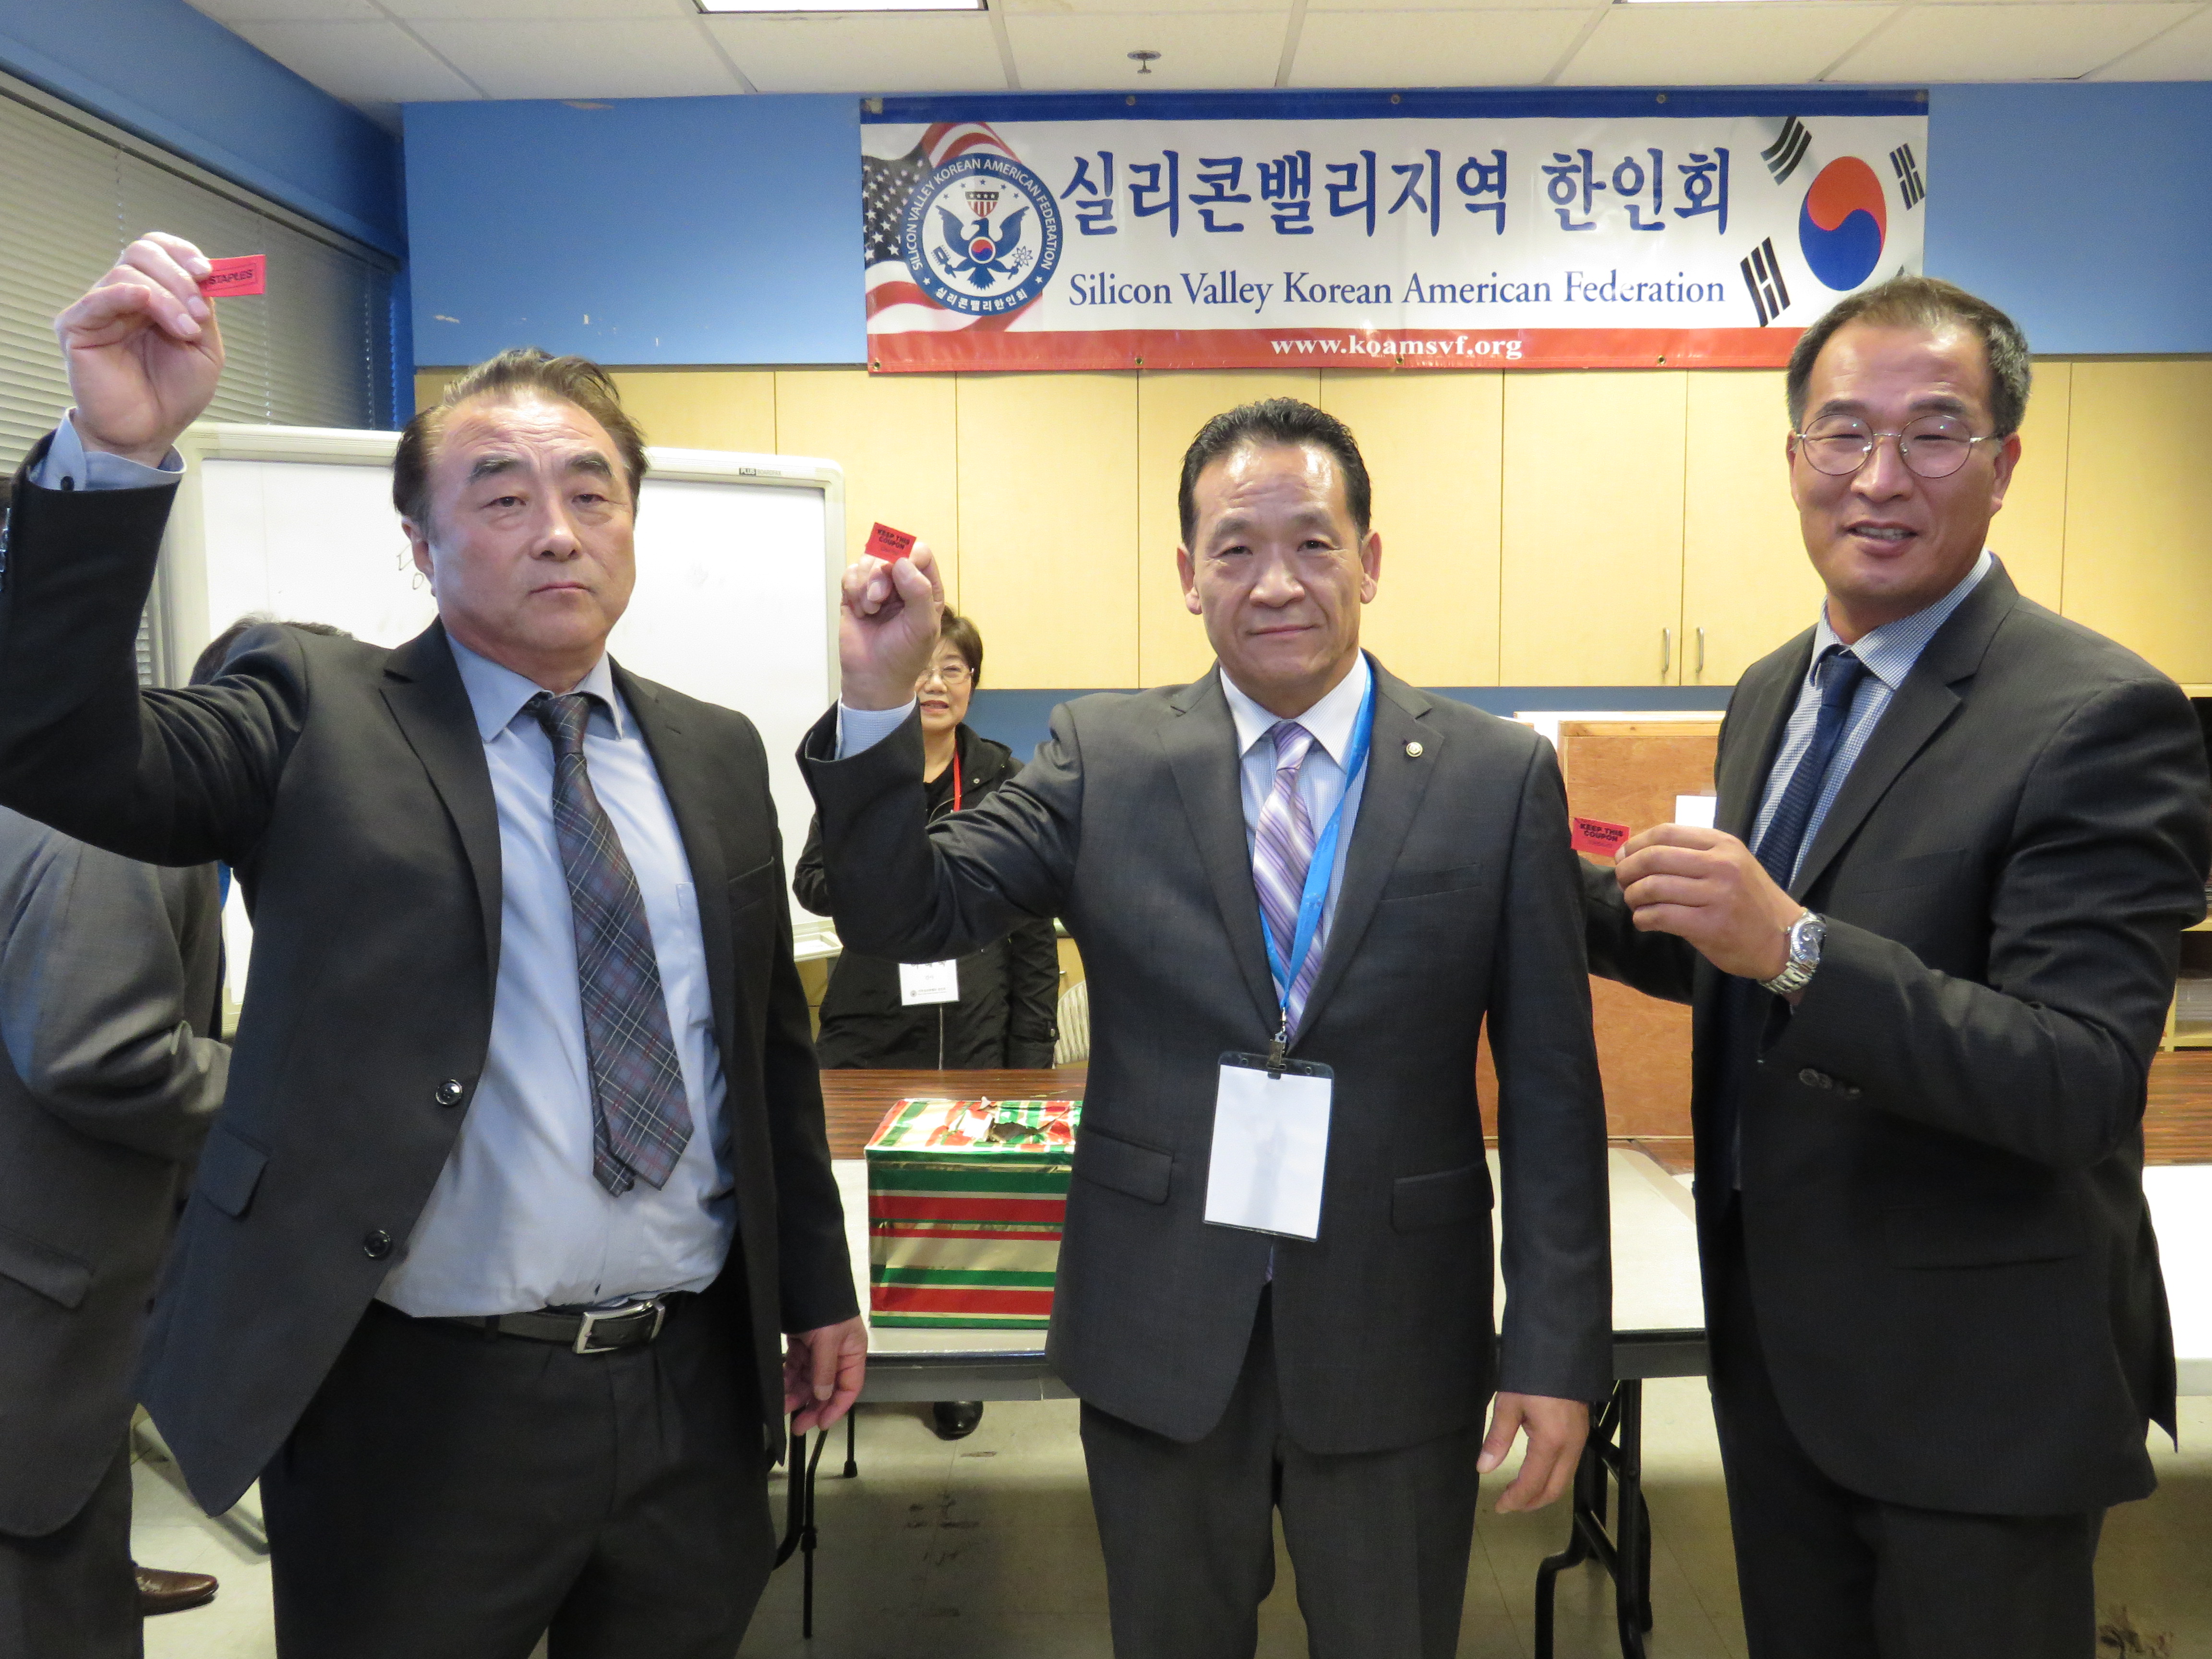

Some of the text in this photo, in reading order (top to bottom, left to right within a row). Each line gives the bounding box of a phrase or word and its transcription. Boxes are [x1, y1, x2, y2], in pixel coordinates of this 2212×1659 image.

[1059, 147, 1730, 238] 실리콘밸리지역 한인회
[906, 158, 1058, 271] SILICON VALLEY KOREAN AMERICAN FEDERATION
[936, 287, 1028, 312] 실리콘밸리한인회
[1069, 269, 1725, 314] Silicon Valley Korean American Federation
[1271, 335, 1523, 361] www.koamsvf.org
[1584, 831, 1618, 842] COUPON
[1604, 828, 1623, 836] THIS
